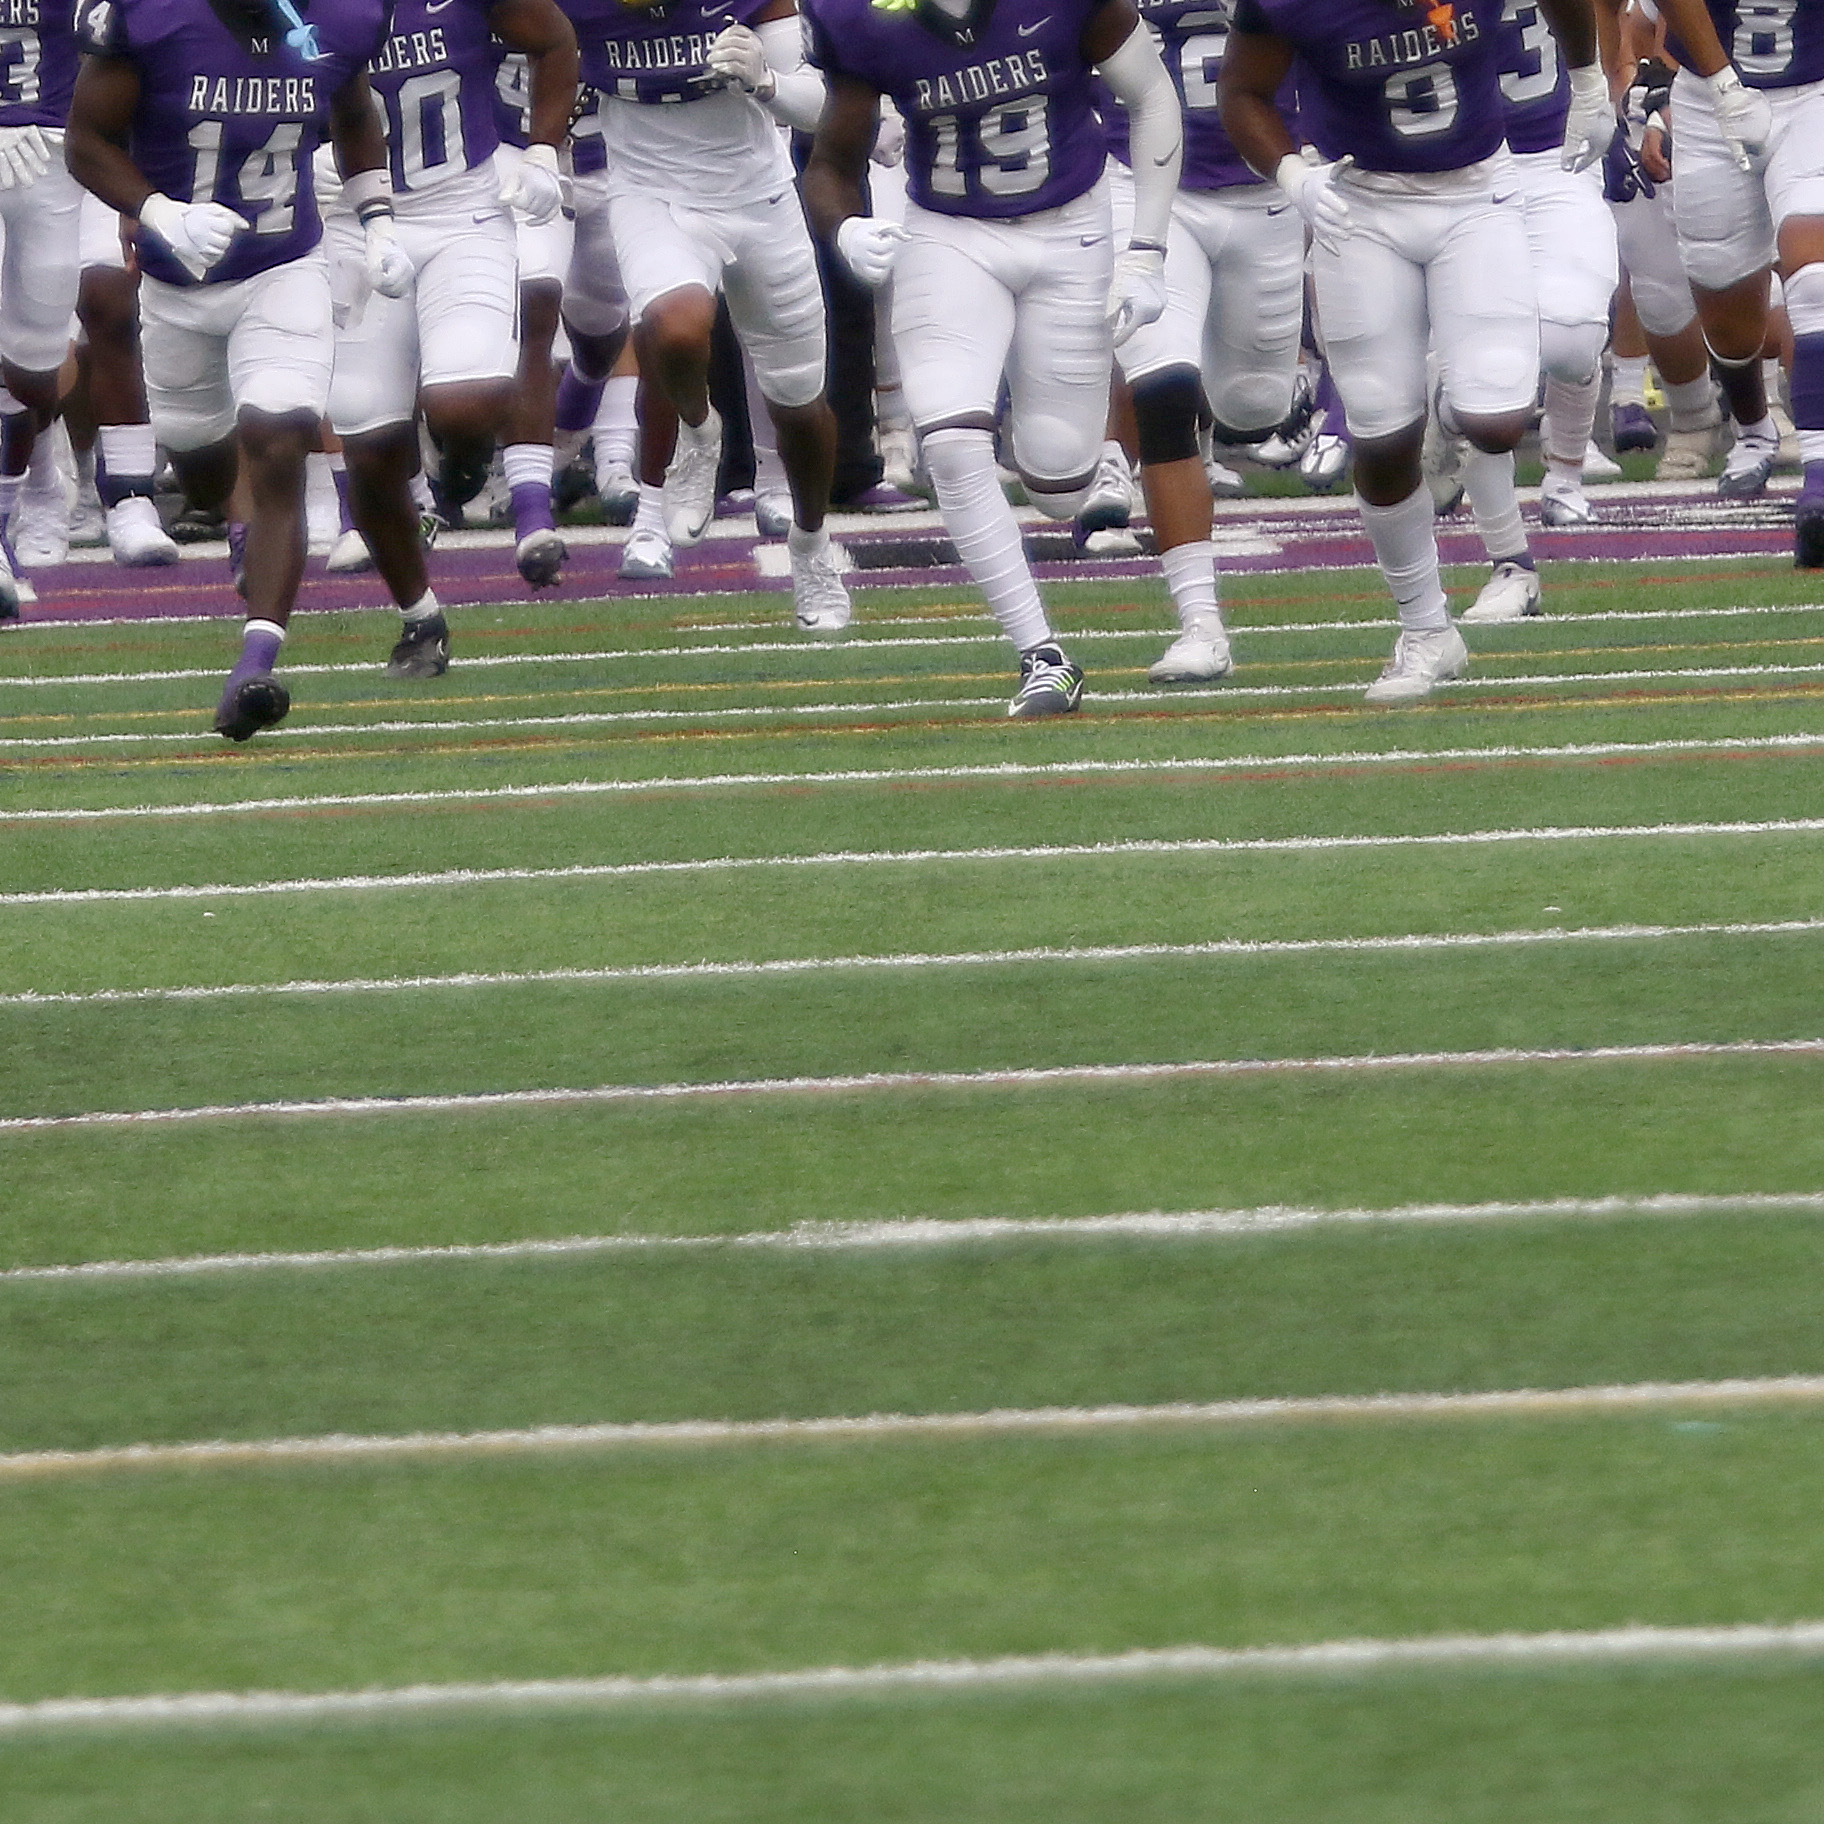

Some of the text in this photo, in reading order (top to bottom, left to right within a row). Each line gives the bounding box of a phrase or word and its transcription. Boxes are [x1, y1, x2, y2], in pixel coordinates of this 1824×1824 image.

[251, 38, 269, 54] M
[916, 48, 1049, 112] RAIDERS
[188, 75, 317, 114] RAIDERS
[370, 68, 469, 191] 0
[1384, 60, 1460, 136] 9
[186, 120, 305, 236] 14
[928, 94, 1050, 198] 19
